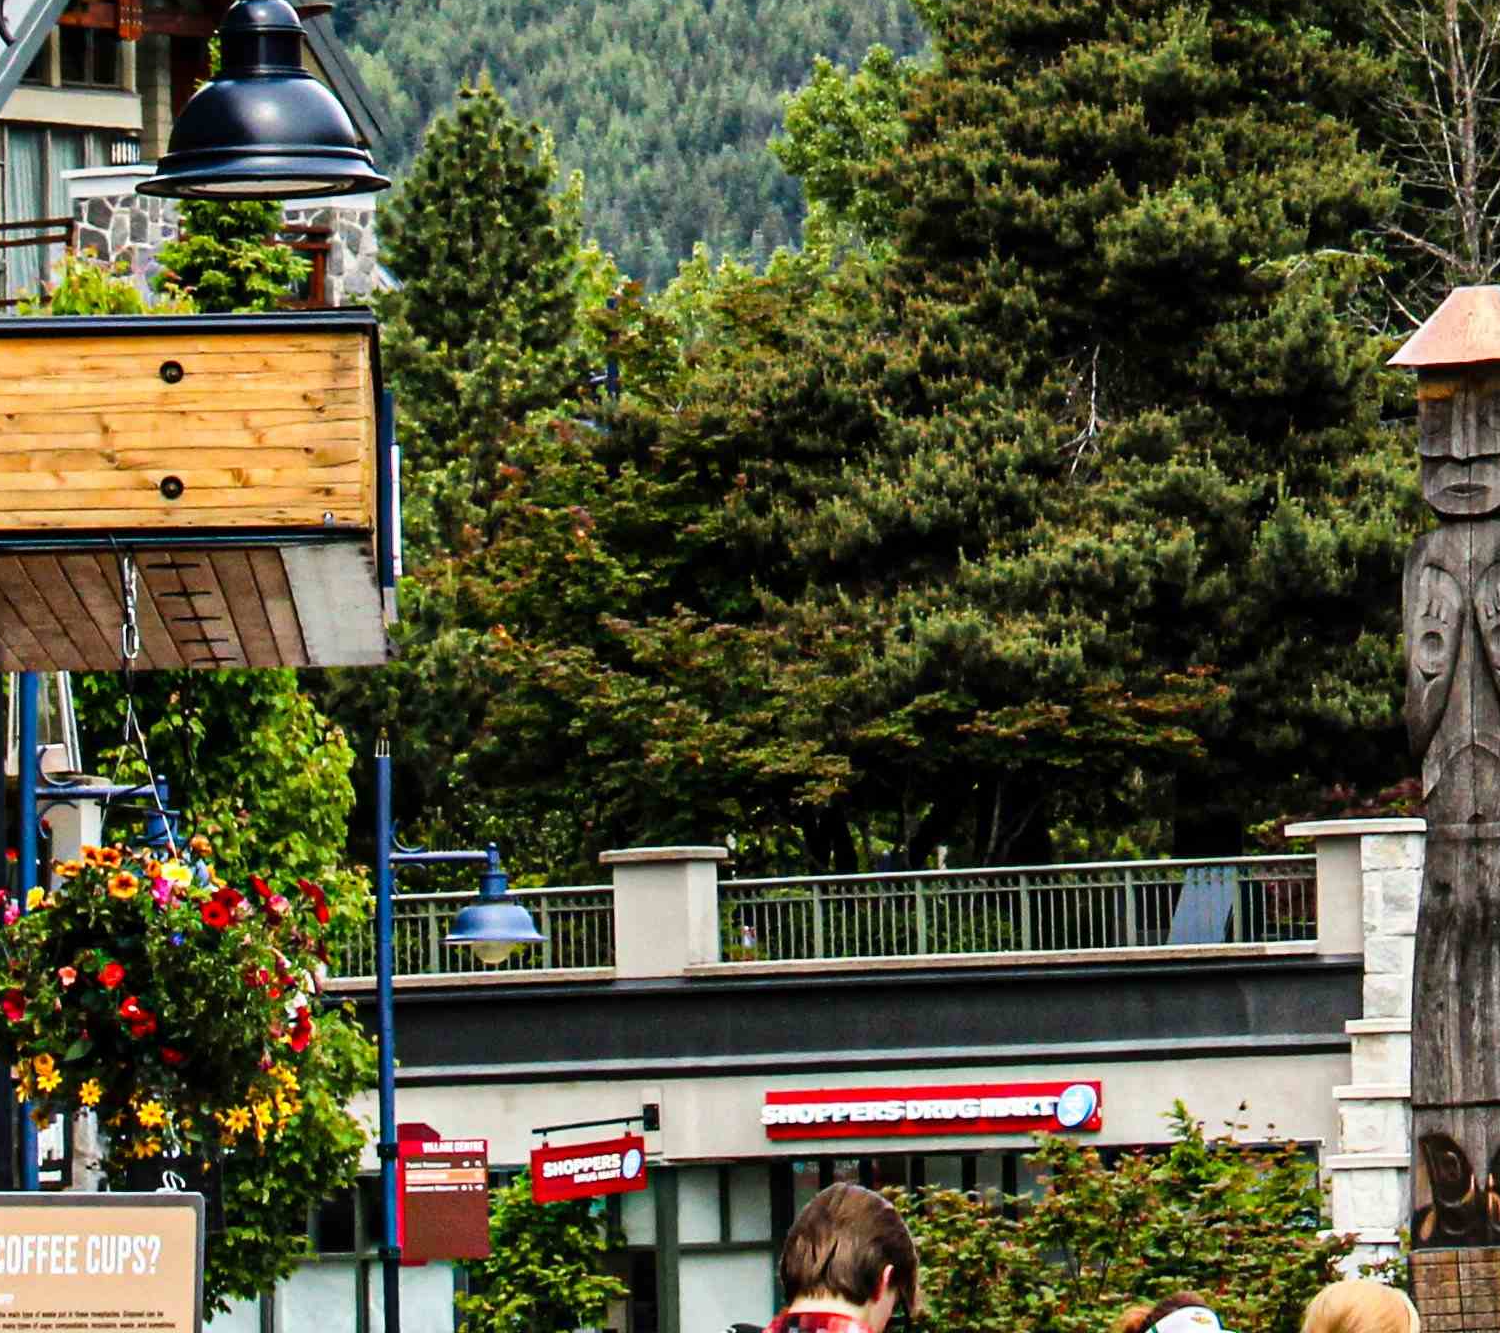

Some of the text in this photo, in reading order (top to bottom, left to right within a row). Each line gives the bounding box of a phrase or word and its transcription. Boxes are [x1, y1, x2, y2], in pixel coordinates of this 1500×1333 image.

[760, 1100, 905, 1125] SHOPPERS
[906, 1099, 980, 1120] DRUG
[543, 1153, 621, 1178] SHOPPERS
[86, 1235, 161, 1275] CUPS?
